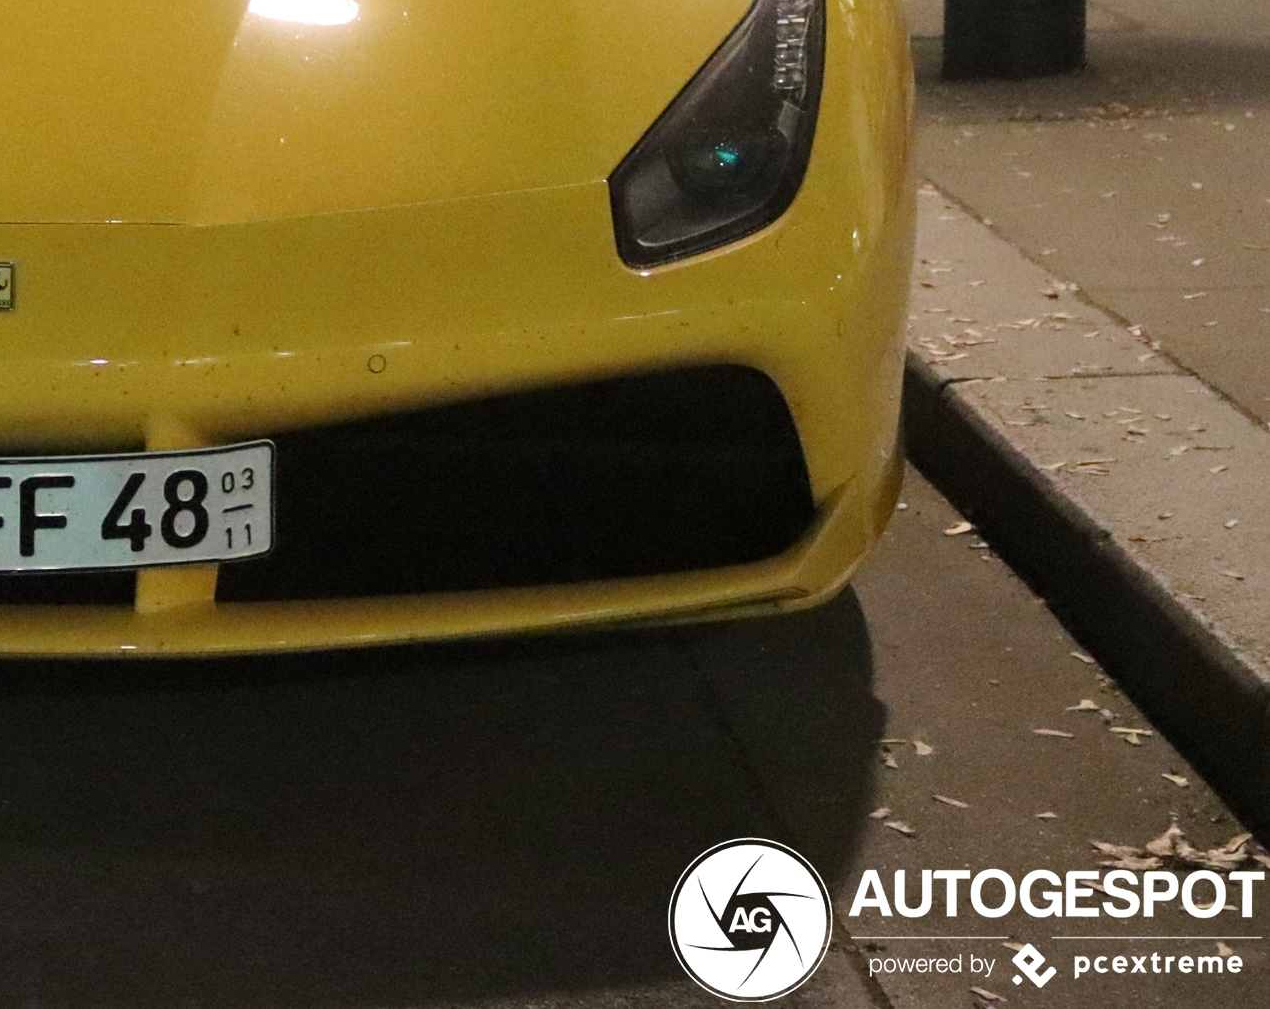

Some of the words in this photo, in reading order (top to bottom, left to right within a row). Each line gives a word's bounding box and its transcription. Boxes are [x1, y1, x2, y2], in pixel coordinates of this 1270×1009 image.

[221, 467, 254, 494] 03
[101, 469, 209, 552] 48
[225, 523, 252, 549] 11
